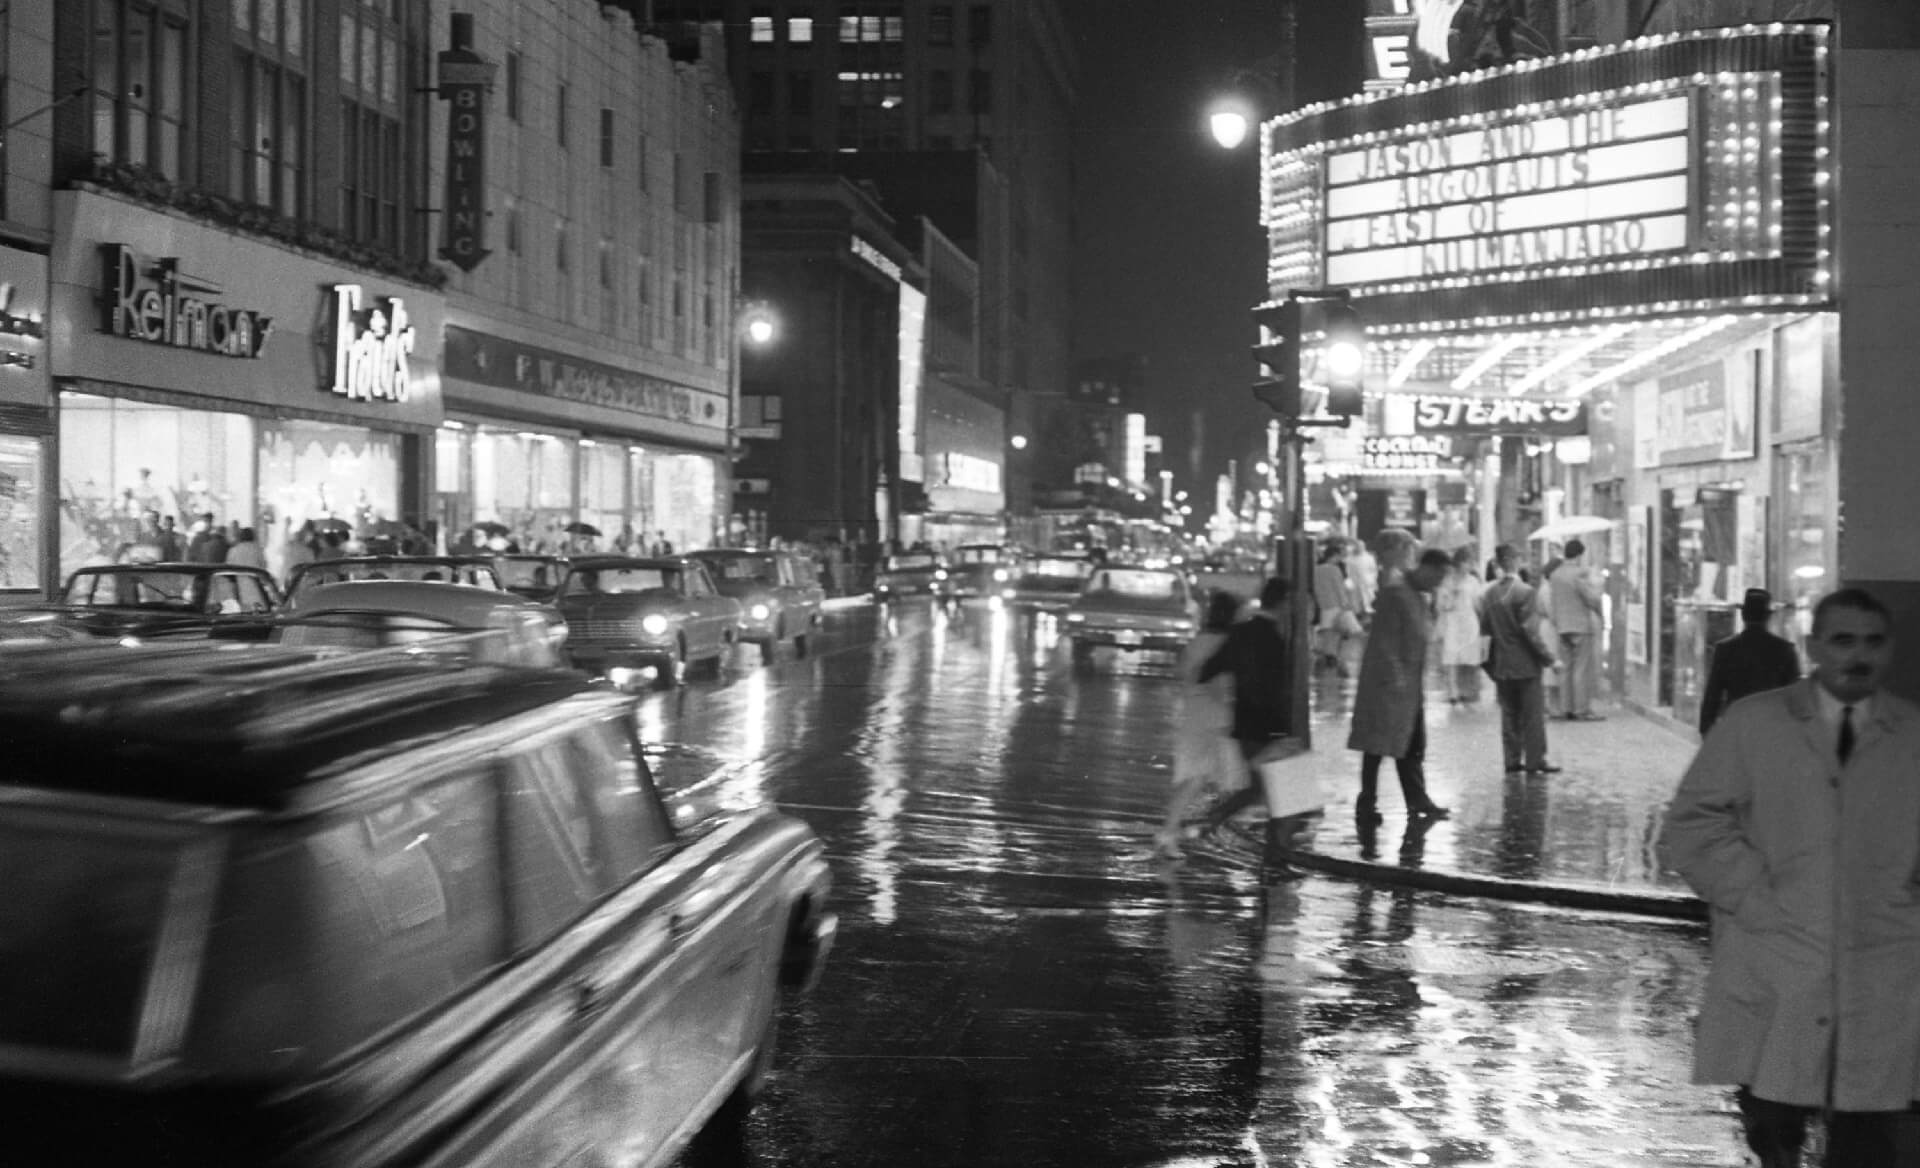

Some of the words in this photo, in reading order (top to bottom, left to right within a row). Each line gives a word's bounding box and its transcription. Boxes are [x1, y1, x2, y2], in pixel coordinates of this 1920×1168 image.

[1356, 139, 1454, 180] JASON
[1479, 121, 1536, 160] AND
[1563, 105, 1627, 147] THE
[454, 89, 477, 256] BOWLING
[1393, 152, 1590, 207] ARGONAUTS
[1366, 211, 1438, 248] EAST
[1467, 202, 1507, 233] OF
[1420, 219, 1646, 276] KILIMANJARO
